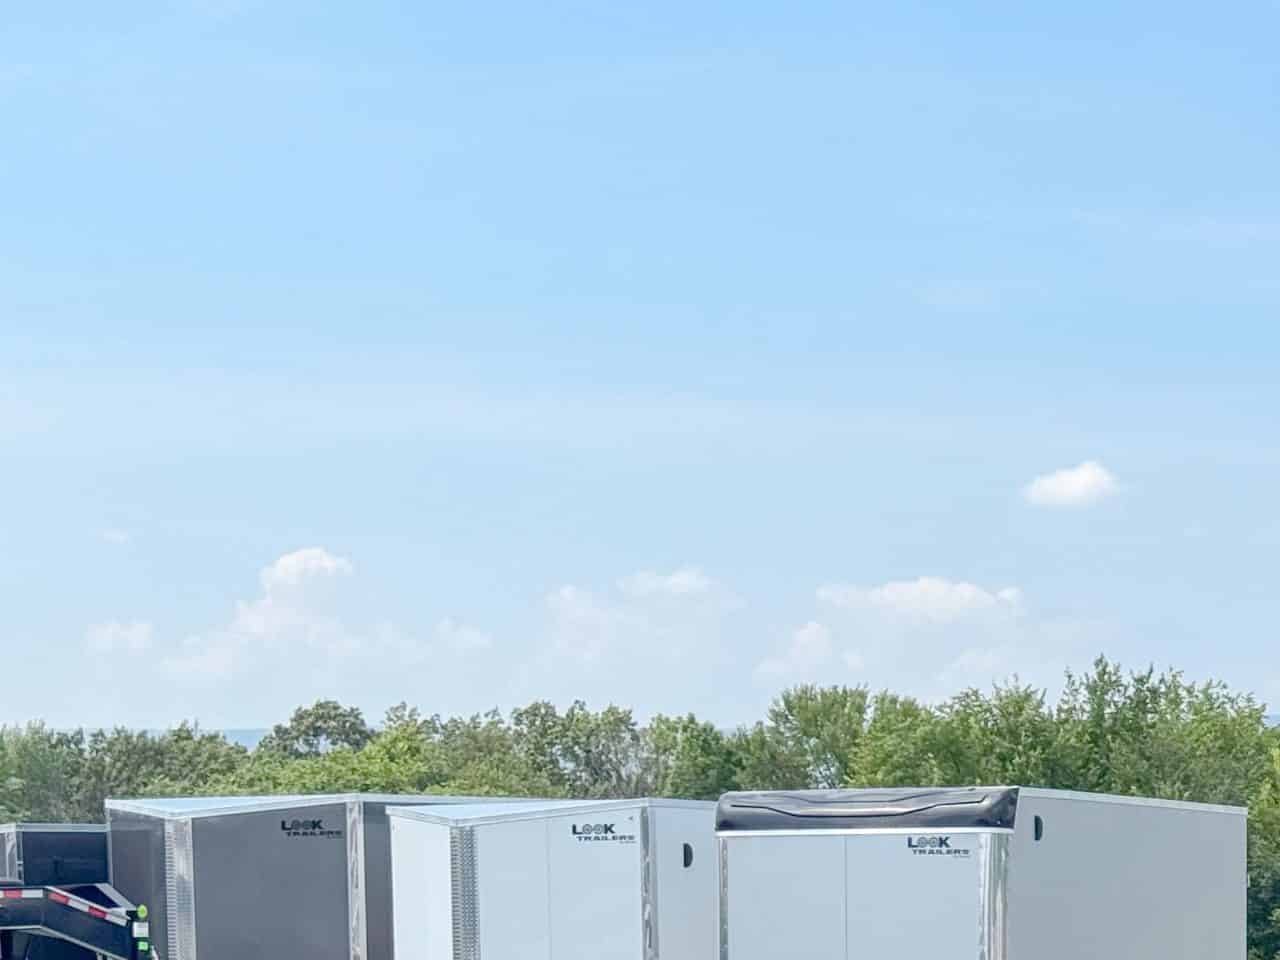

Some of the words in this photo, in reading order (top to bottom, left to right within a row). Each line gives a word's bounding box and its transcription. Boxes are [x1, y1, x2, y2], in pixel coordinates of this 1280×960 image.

[281, 820, 322, 831] LOOK
[572, 823, 616, 835] LOOK
[907, 837, 951, 848] LOOK
[912, 848, 970, 856] TRAILERS
